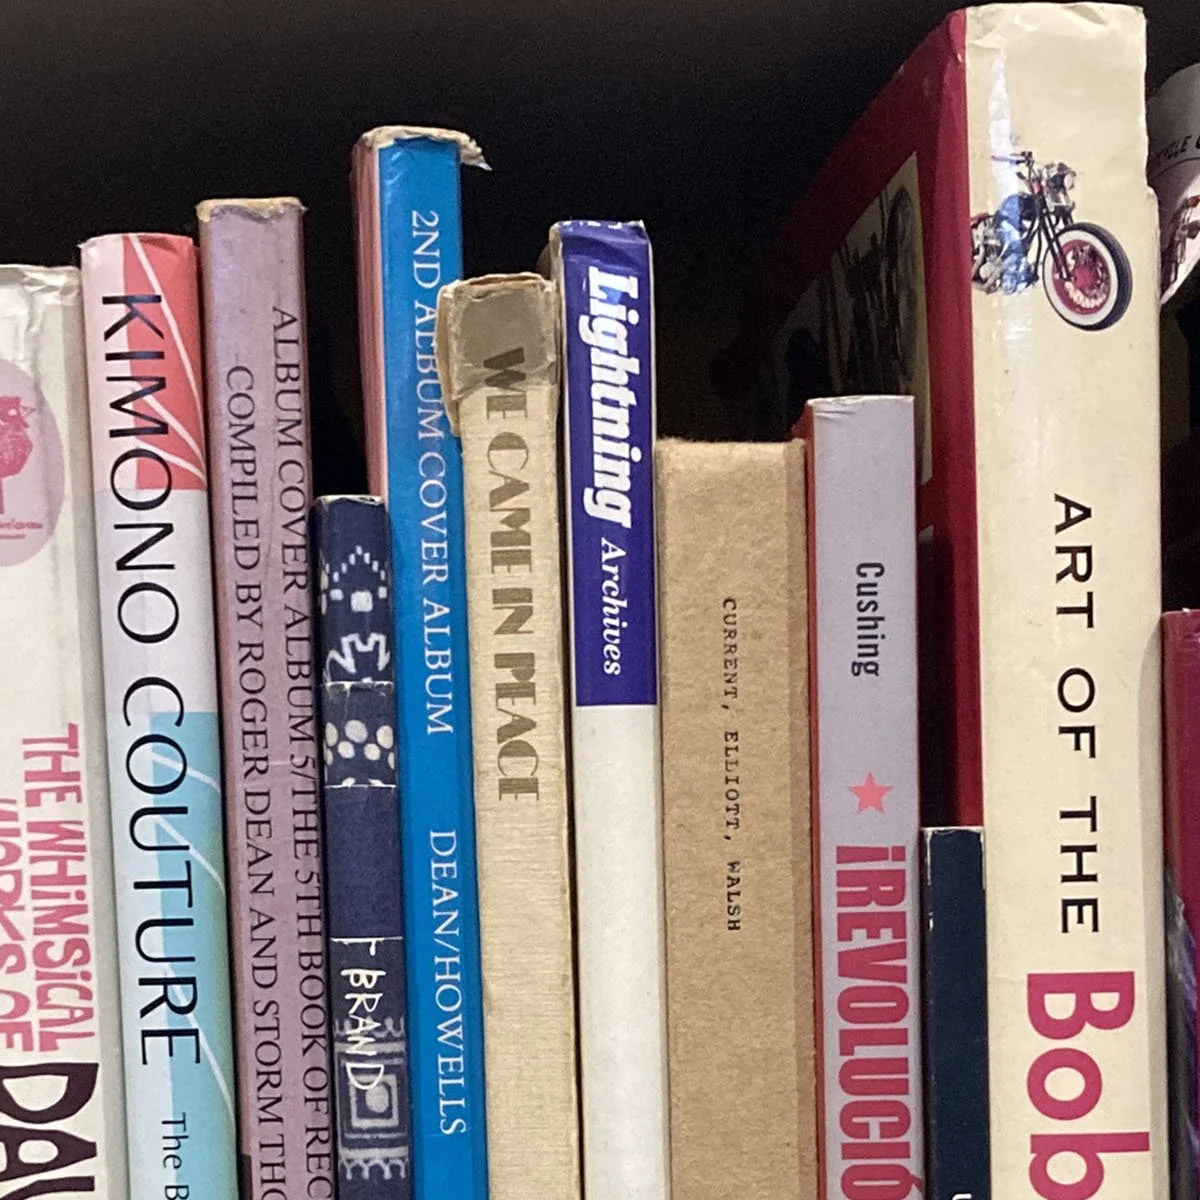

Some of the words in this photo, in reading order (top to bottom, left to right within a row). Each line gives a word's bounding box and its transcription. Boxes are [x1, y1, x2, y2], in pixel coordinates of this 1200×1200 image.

[412, 210, 442, 289] 2ND
[271, 305, 305, 449] ALBUM
[482, 346, 528, 421] WE
[577, 267, 641, 529] Lightning
[102, 294, 179, 645] KIMONO
[225, 364, 264, 573] COMPILED
[277, 458, 308, 594] COVER
[418, 449, 450, 587] COVER
[486, 431, 533, 574] CAME
[234, 580, 265, 626] BY
[491, 587, 535, 636] IN
[600, 537, 626, 677] Archives
[850, 561, 886, 678] Cushing
[1054, 493, 1096, 629] ART
[237, 638, 271, 782] ROGER
[283, 606, 315, 742] ALBUM
[422, 599, 454, 735] ALBUM
[720, 597, 739, 712] CURRENT,
[1057, 667, 1097, 759] OF
[22, 723, 83, 809] THE
[494, 651, 540, 803] PEACE
[723, 730, 742, 842] ELLIOTT,
[122, 676, 201, 1067] COUTURE
[241, 791, 275, 897] DEAN
[294, 869, 324, 939] 5TH
[726, 860, 742, 932] WALSH
[1060, 795, 1100, 934] THE
[249, 905, 280, 989] AND
[298, 948, 330, 1056] BOOK
[428, 830, 470, 1137] DEAN/HOWELLS
[252, 1000, 285, 1125] STORM
[302, 1065, 332, 1117] OF
[339, 968, 388, 1091] BRAND
[161, 1112, 190, 1170] The
